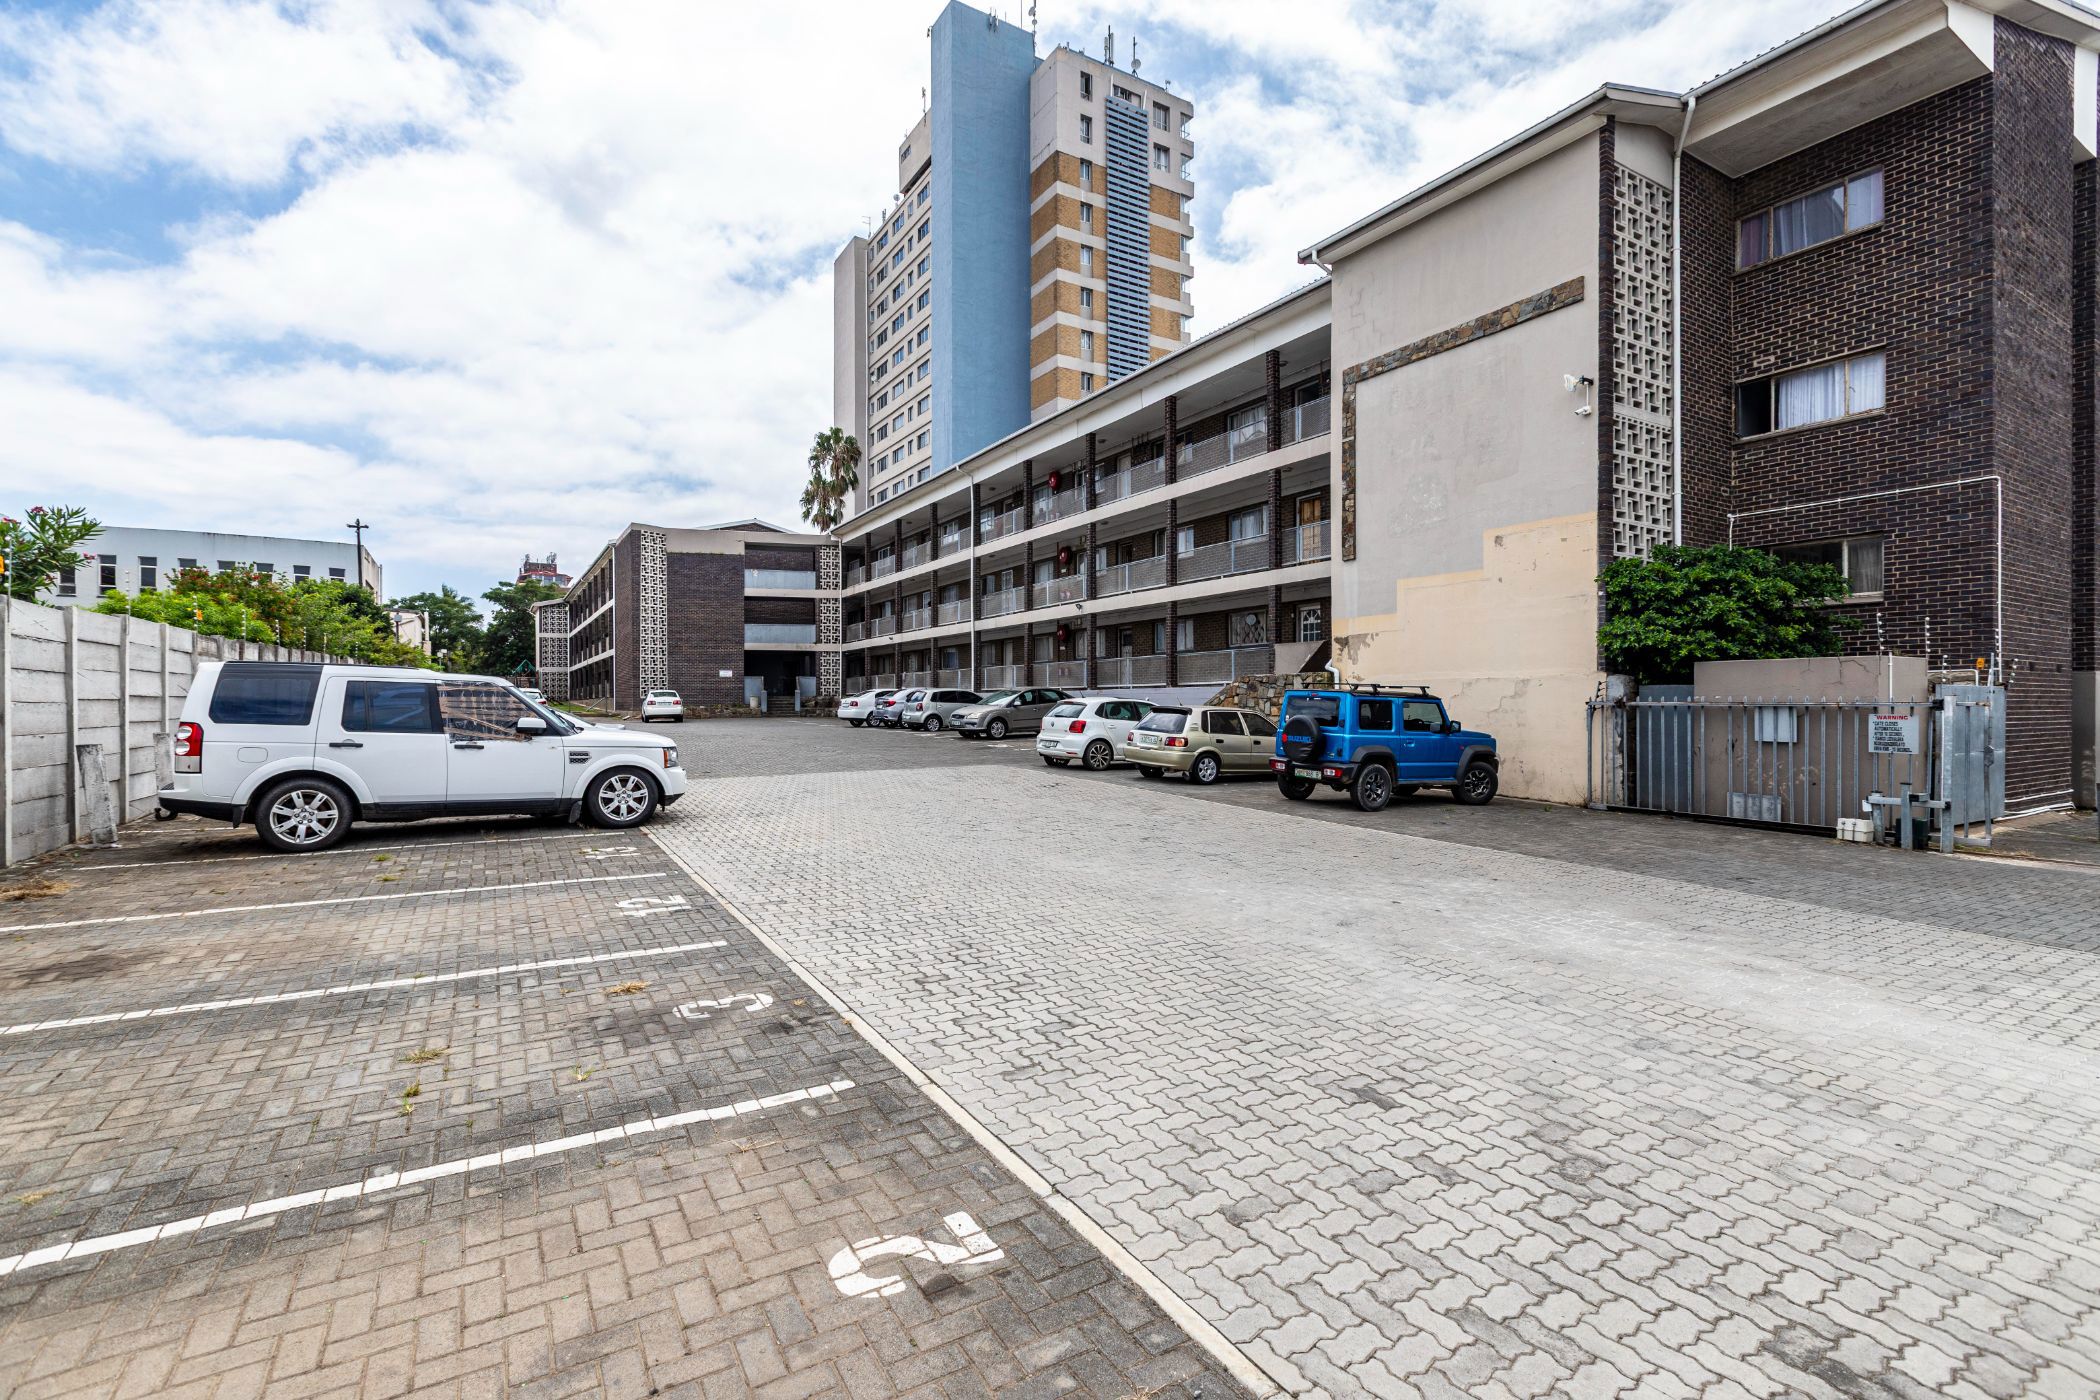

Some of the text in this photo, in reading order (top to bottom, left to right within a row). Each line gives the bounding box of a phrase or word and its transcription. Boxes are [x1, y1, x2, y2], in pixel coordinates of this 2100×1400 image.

[1287, 735, 1313, 743] SUZUKI
[671, 992, 774, 1019] 3
[827, 1210, 1004, 1298] 2
